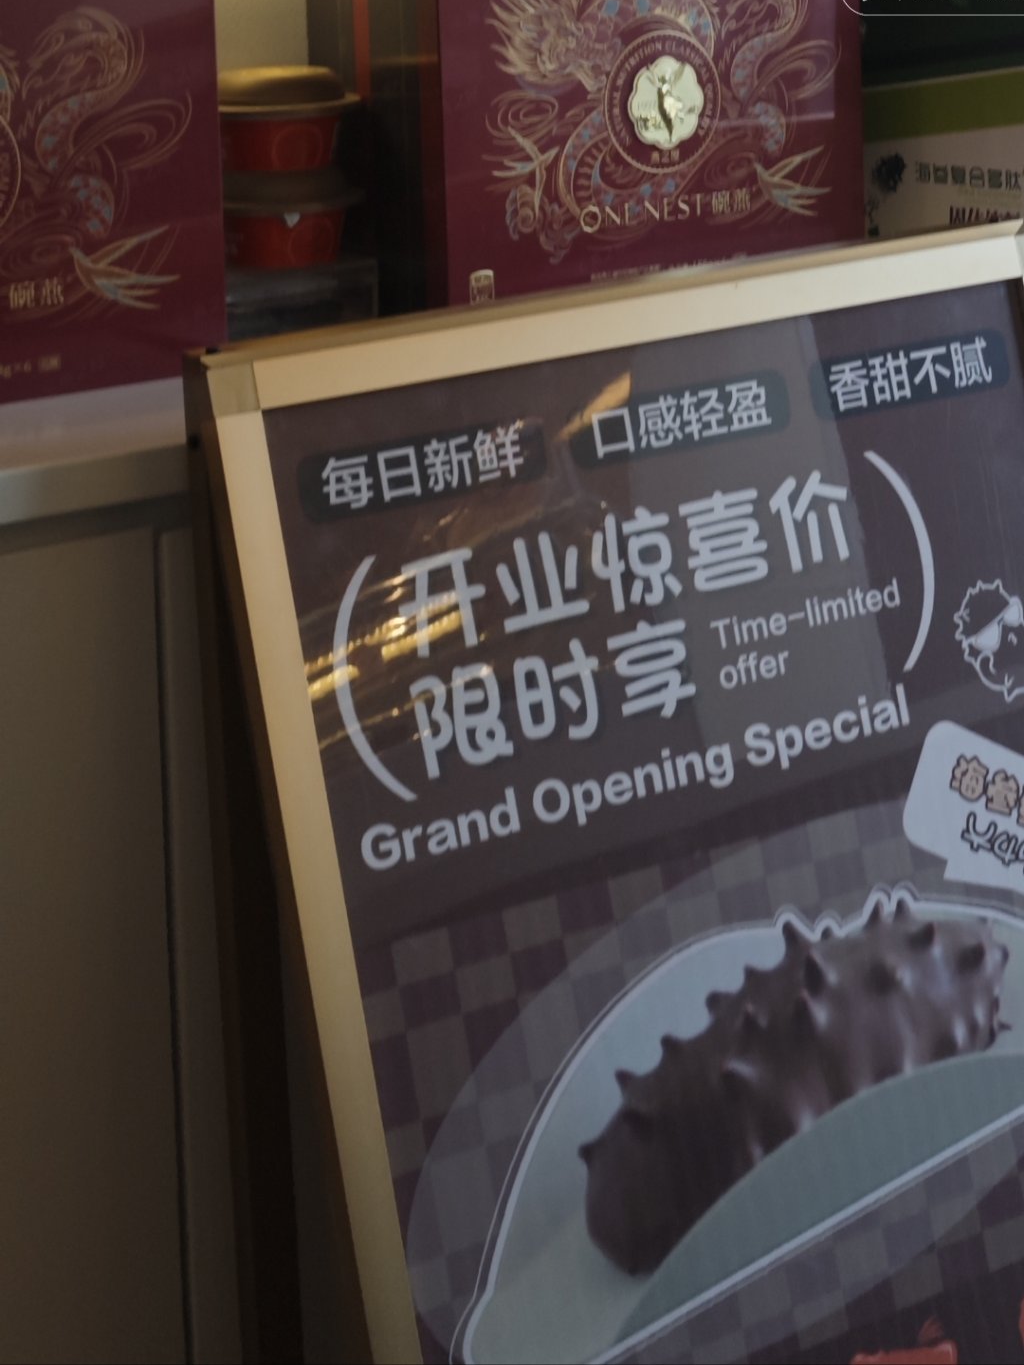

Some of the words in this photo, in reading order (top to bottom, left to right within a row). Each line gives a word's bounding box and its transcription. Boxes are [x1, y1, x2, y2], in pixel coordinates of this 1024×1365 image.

[644, 191, 704, 222] NEST
[829, 336, 993, 412] 香甜不腻
[592, 379, 772, 459] 口感轻盈
[321, 420, 525, 510] 每日新鲜
[398, 471, 851, 659] 开业惊喜价
[710, 577, 900, 649] Time-limited
[410, 617, 696, 780] 限时享
[719, 650, 789, 689] offer
[360, 788, 520, 871] Grand
[531, 742, 735, 831] Opening
[745, 684, 911, 775] Special
